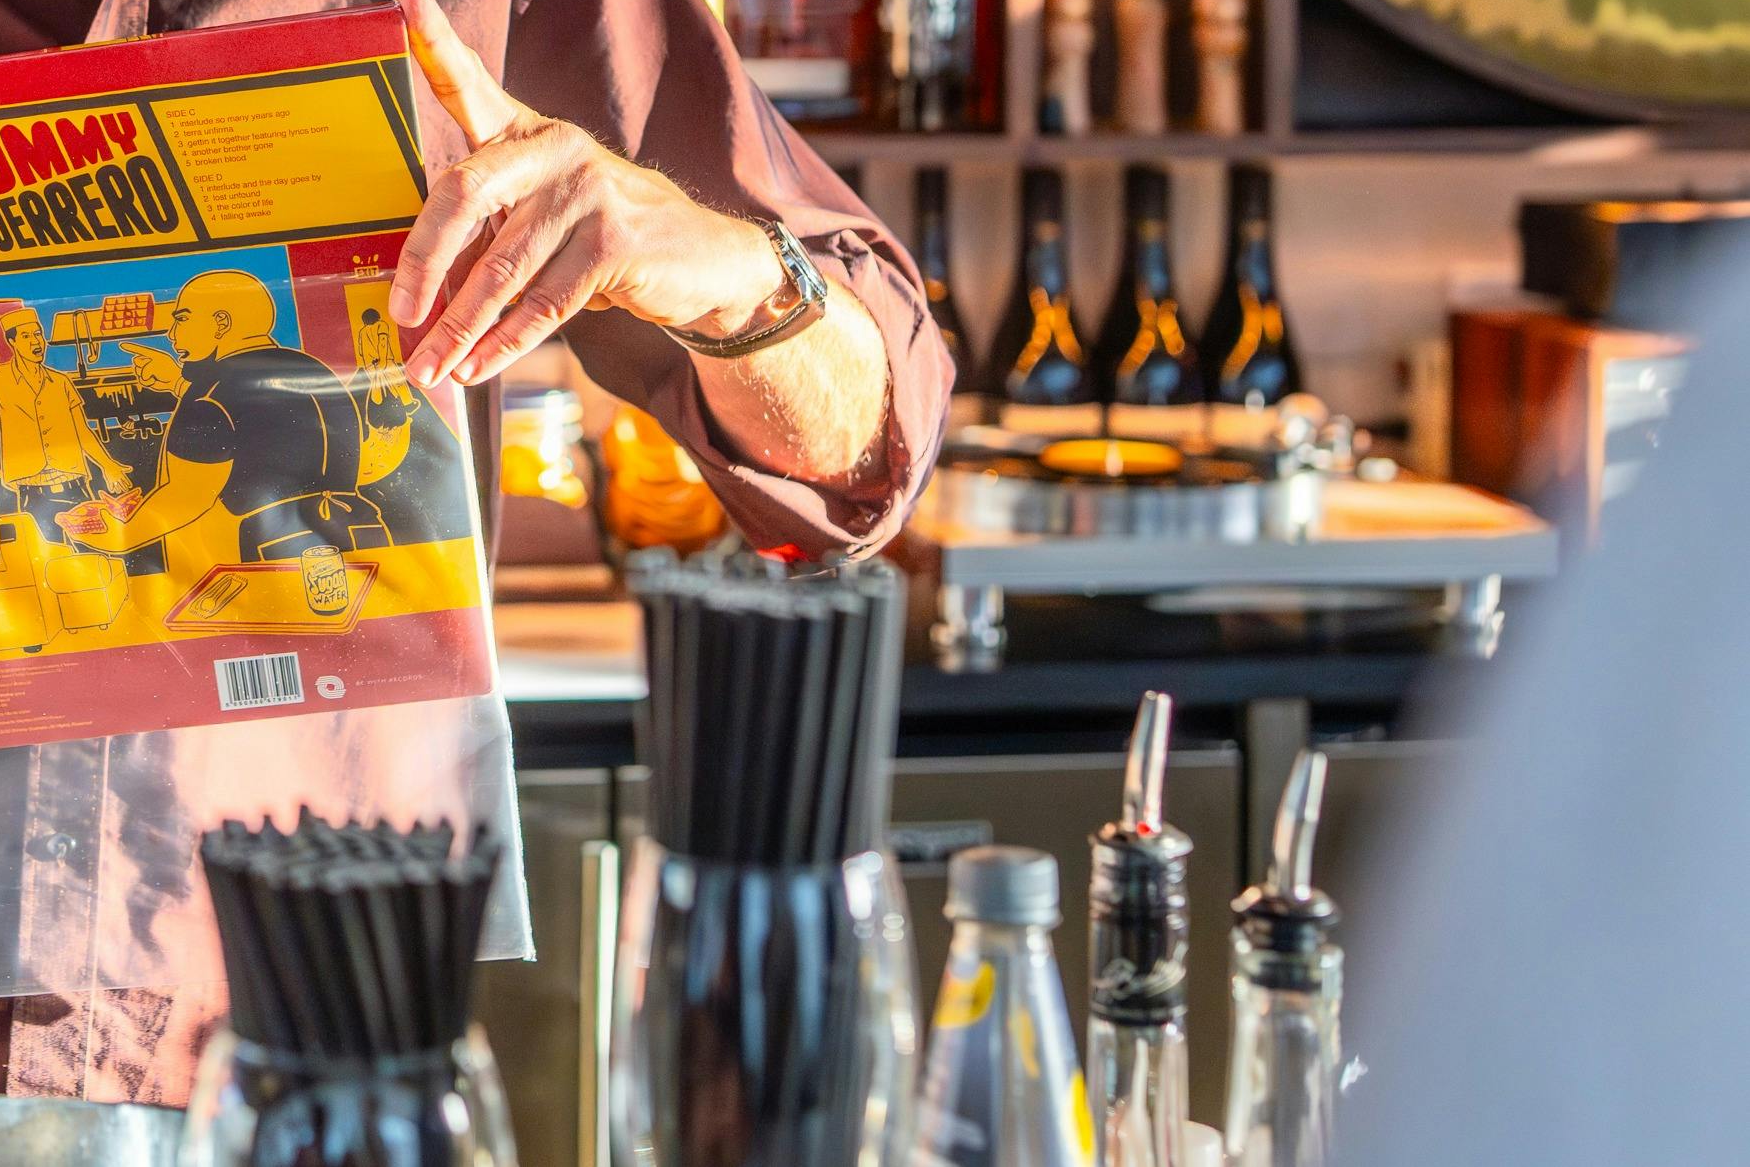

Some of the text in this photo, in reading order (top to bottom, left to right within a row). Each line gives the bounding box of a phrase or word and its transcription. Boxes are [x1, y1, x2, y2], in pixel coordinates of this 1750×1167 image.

[166, 109, 186, 118] SIDE
[180, 117, 214, 127] interlude
[227, 114, 249, 123] many
[251, 112, 273, 121] years
[275, 110, 290, 119] ago
[187, 138, 209, 148] gettin
[218, 133, 251, 144] together
[252, 130, 286, 140] featuring
[191, 147, 222, 156] another
[224, 144, 251, 153] brother
[253, 142, 273, 151] gone
[195, 157, 223, 166] broken
[224, 154, 247, 163] blood
[194, 175, 214, 183] SIDE
[207, 183, 240, 192] interlude
[259, 178, 272, 186] the
[274, 177, 288, 186] day
[290, 175, 310, 185] goes
[311, 174, 321, 182] by
[213, 193, 227, 201] lost
[229, 190, 260, 199] unfound
[217, 203, 229, 211] the
[231, 200, 250, 209] color
[220, 212, 244, 220] falling
[245, 210, 271, 218] awake
[314, 590, 347, 604] WATER
